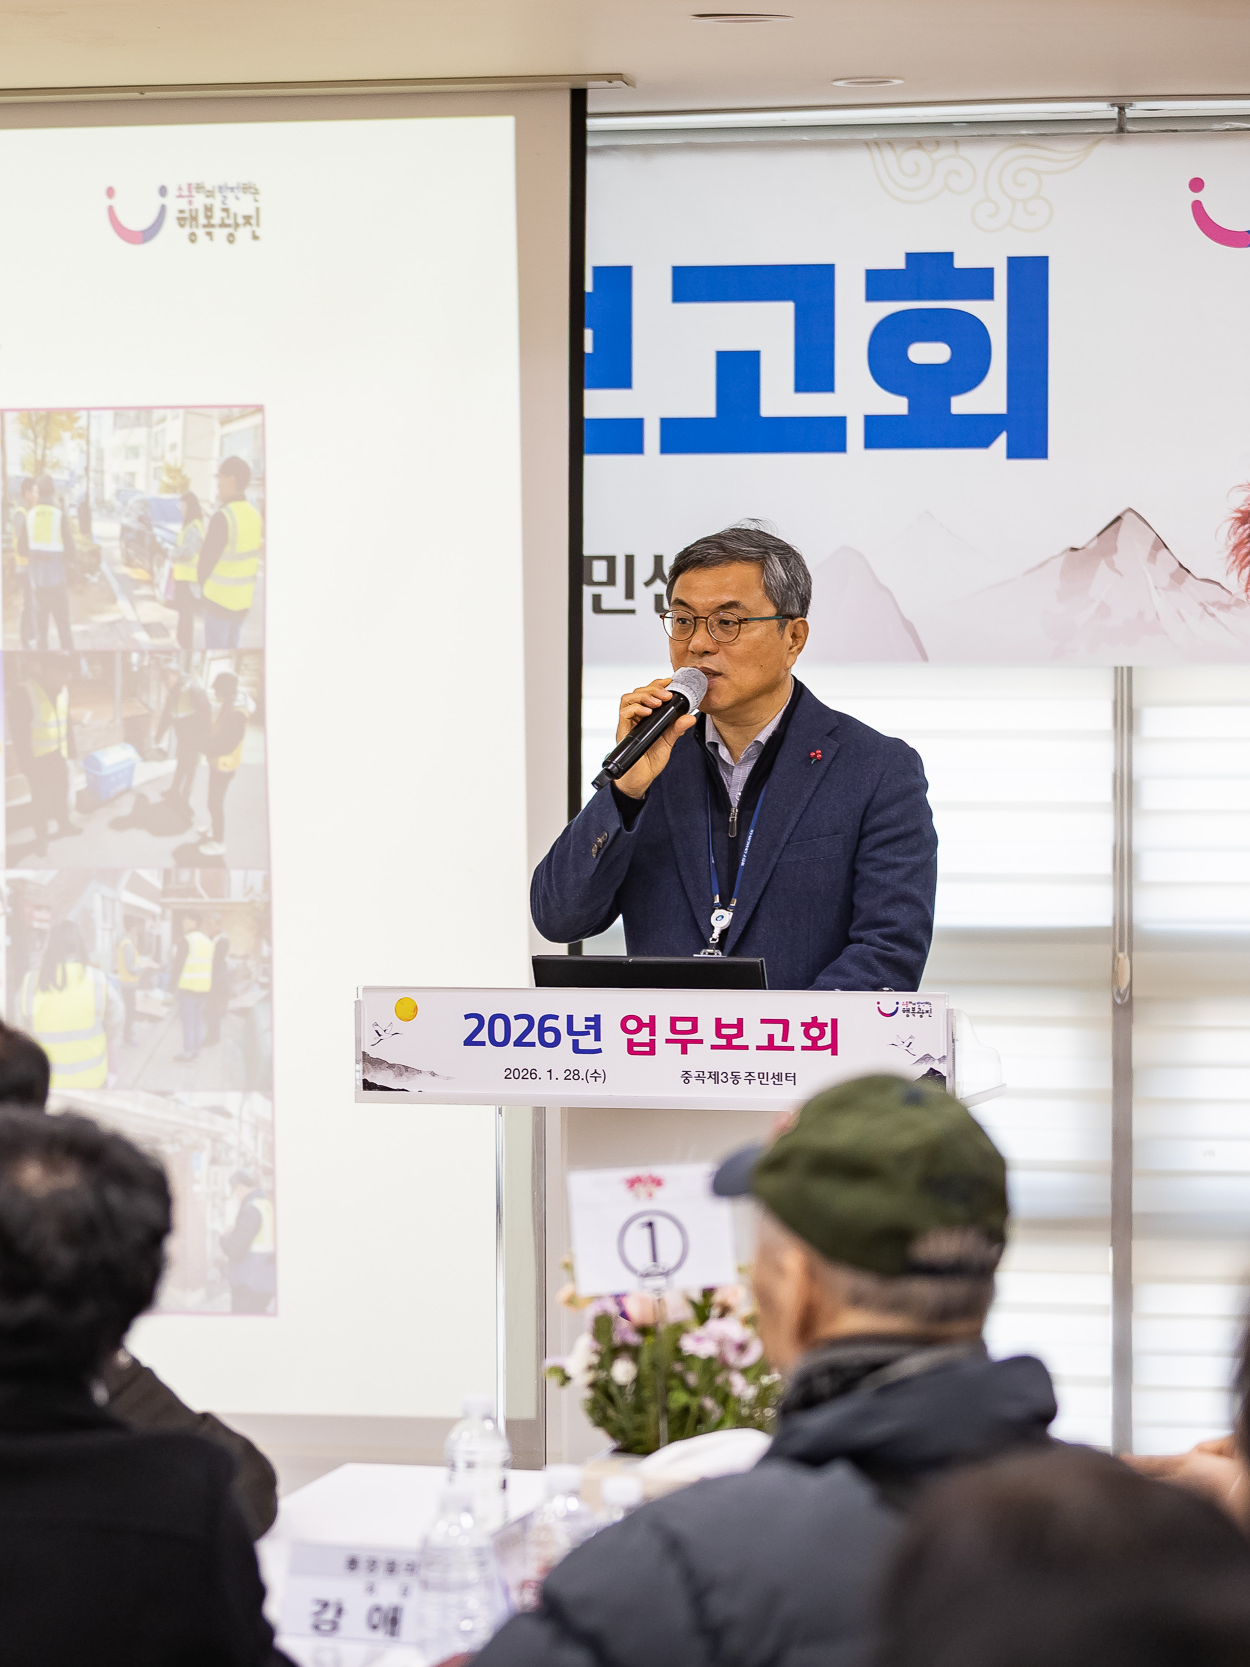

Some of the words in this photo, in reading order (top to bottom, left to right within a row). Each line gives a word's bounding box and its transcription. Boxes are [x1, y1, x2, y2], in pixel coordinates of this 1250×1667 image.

[176, 201, 260, 244] 행복광진
[463, 1012, 602, 1055] 2026년
[620, 1014, 838, 1056] 업무보고회
[503, 1066, 542, 1081] 2026.
[546, 1067, 559, 1081] 1.
[563, 1067, 607, 1084] 28.(수)
[680, 1069, 797, 1086] 중곡제3동주민센터
